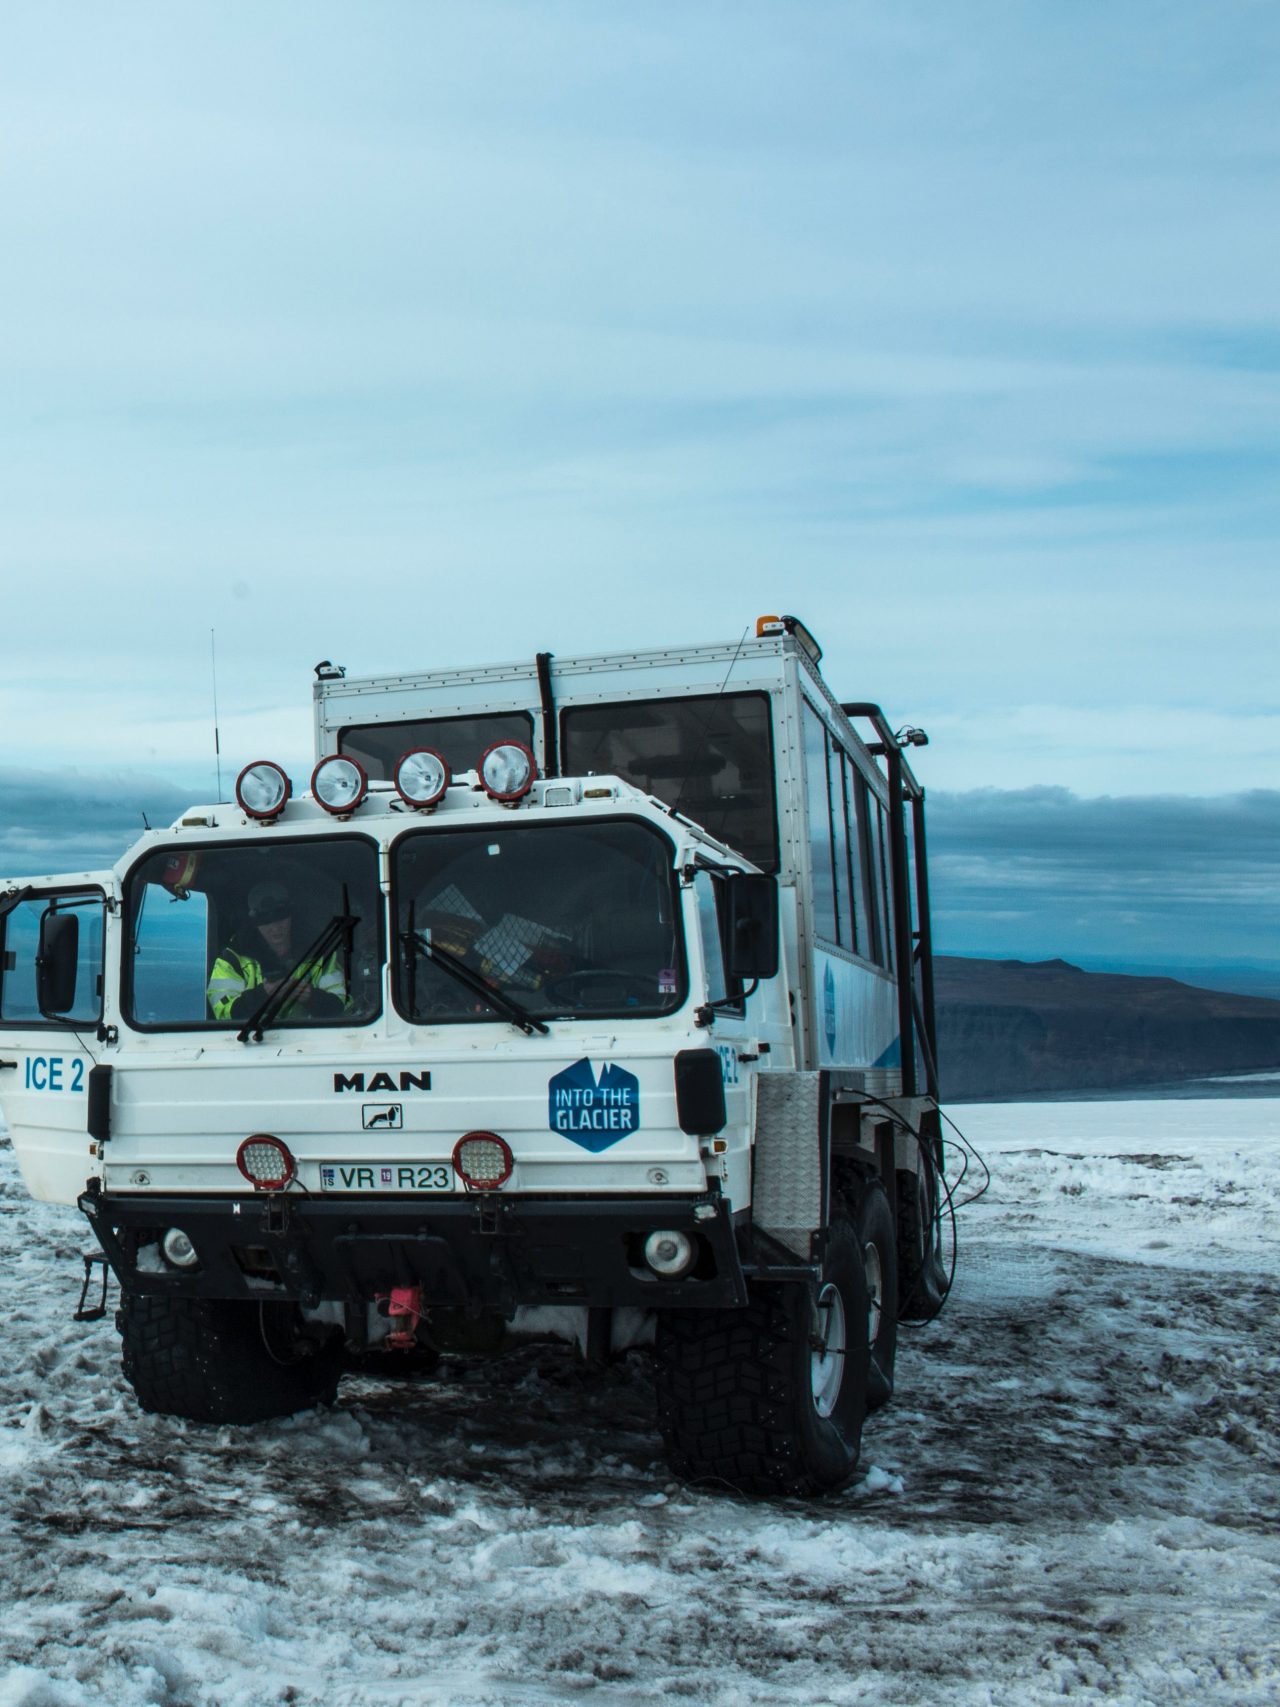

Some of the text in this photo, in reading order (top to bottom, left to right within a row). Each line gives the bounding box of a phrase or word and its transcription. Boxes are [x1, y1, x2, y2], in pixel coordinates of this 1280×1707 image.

[25, 1056, 84, 1092] ICE 2
[333, 1071, 432, 1093] MAN
[555, 1087, 632, 1107] INTO THE
[556, 1108, 632, 1130] GLACIER
[324, 1178, 335, 1187] IS
[339, 1167, 449, 1188] VR R23
[381, 1171, 391, 1181] 19
